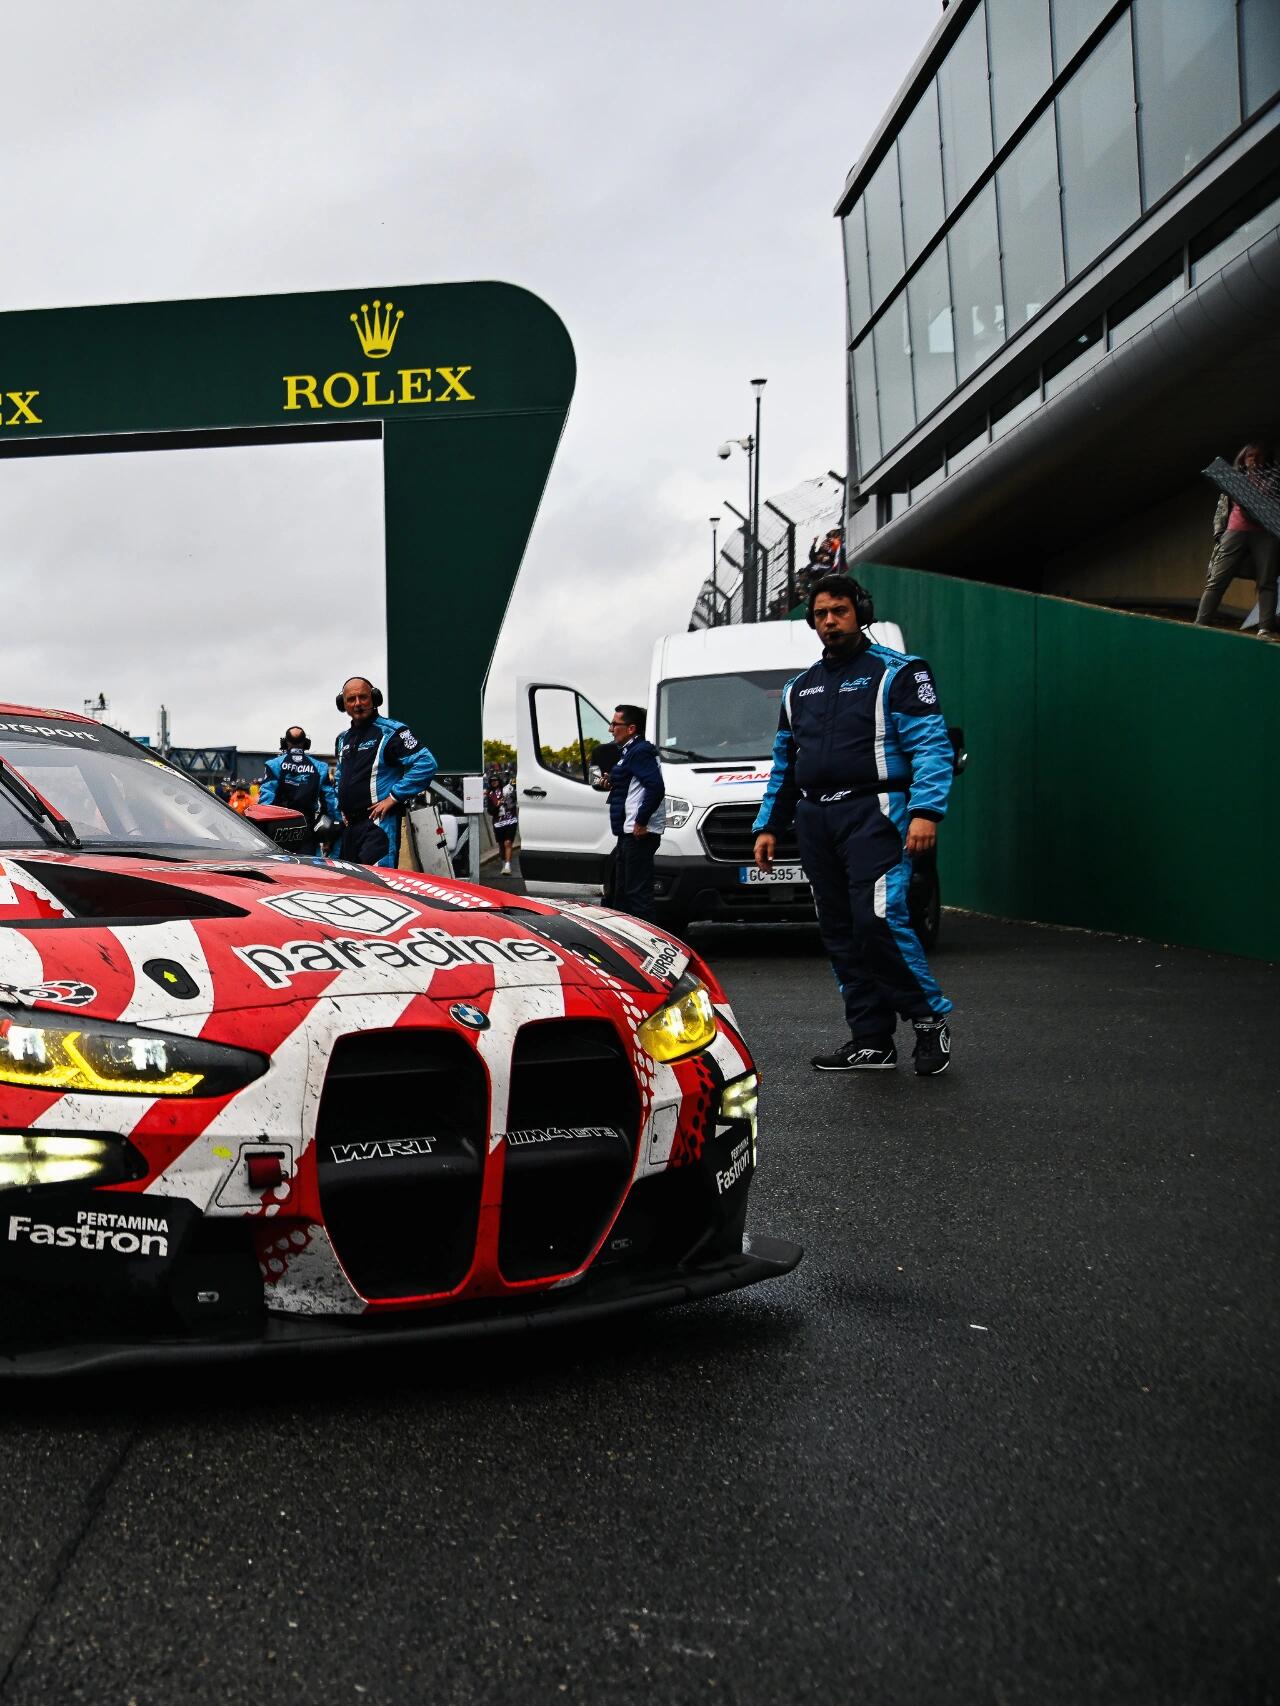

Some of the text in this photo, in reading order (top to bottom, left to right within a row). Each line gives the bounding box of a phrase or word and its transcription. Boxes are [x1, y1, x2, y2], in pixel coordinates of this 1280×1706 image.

[282, 365, 476, 411] ROLEX
[798, 685, 825, 697] OFFICIAL
[281, 763, 315, 774] OFFICIAL
[714, 772, 771, 783] FRAN
[242, 930, 559, 985] paradine
[649, 947, 678, 980] TURBO
[330, 1136, 437, 1164] WRT
[715, 1149, 750, 1195] Fastron
[7, 1215, 169, 1257] Fastron
[76, 1210, 169, 1233] PERTAMINA
